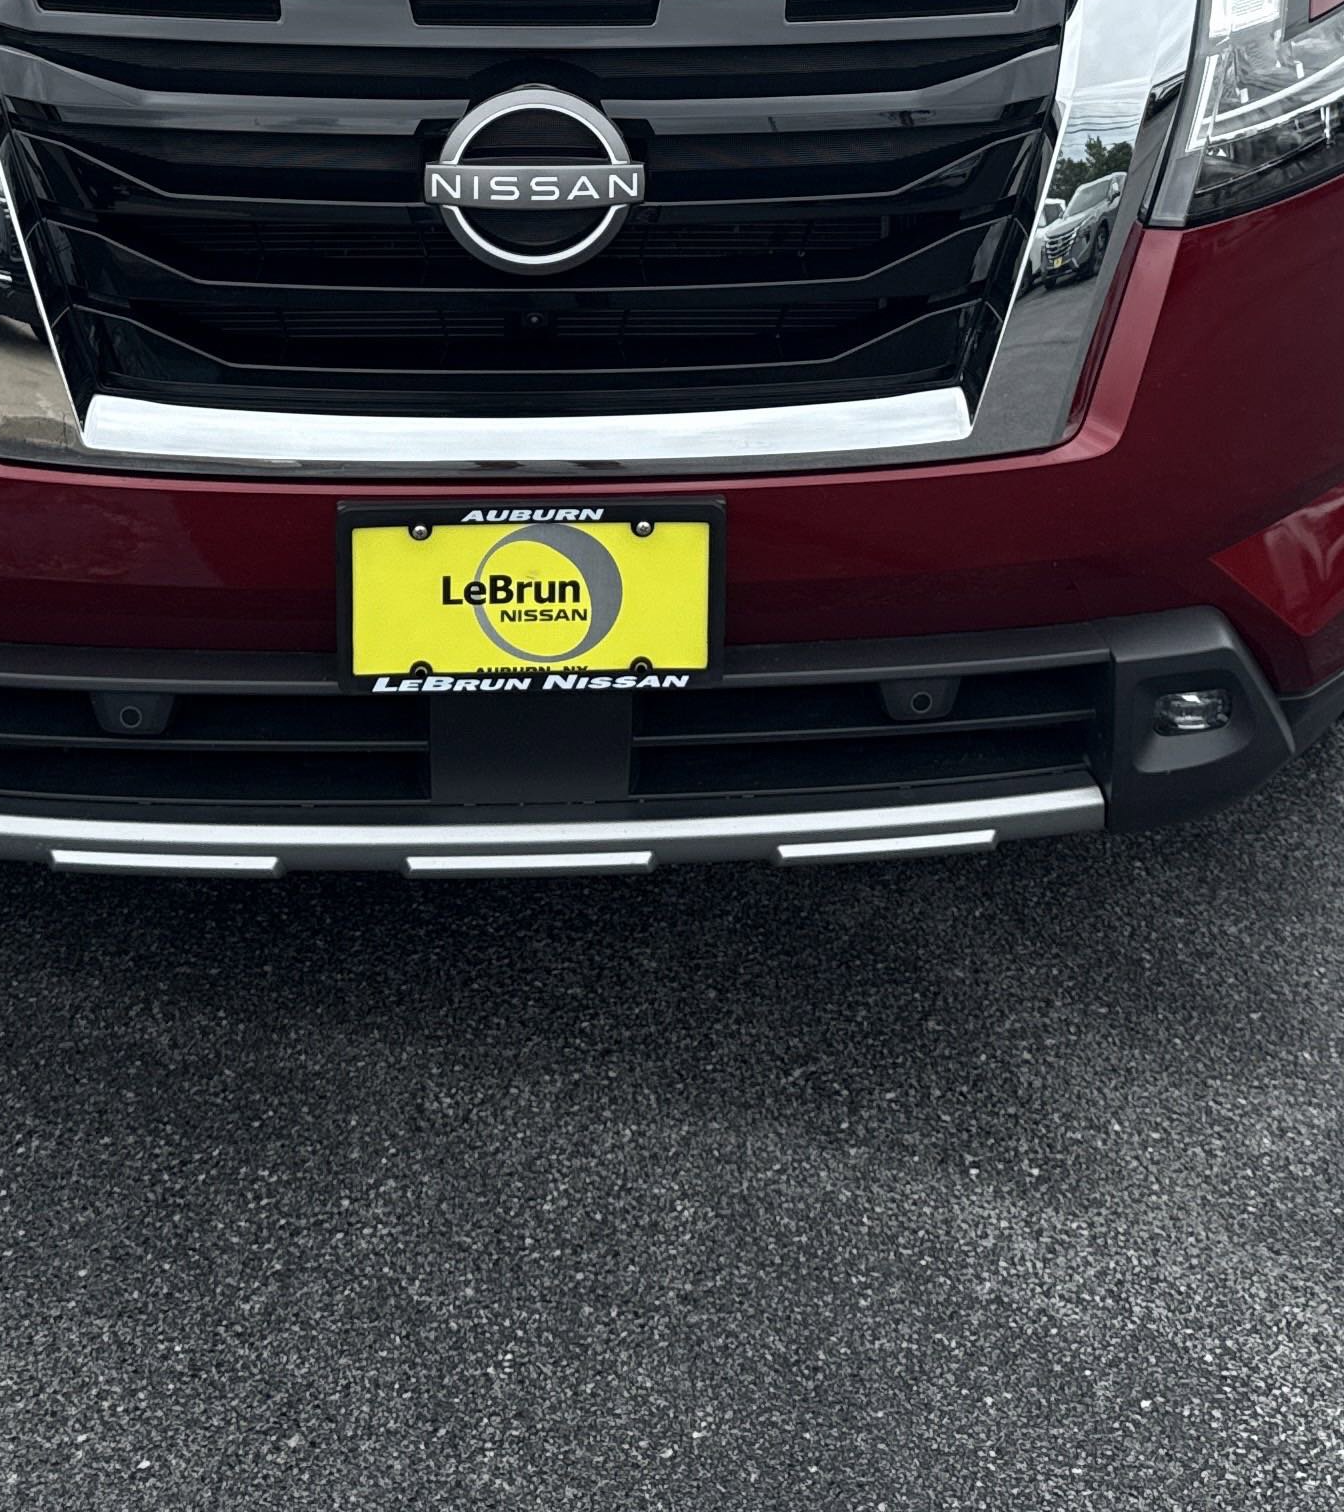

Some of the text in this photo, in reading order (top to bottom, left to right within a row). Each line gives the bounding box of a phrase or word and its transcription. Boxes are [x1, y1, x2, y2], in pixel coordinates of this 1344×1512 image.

[431, 172, 638, 201] NISSAN
[461, 508, 605, 523] AUBURN
[442, 574, 581, 606] LeBrun
[500, 608, 589, 623] NISSAN
